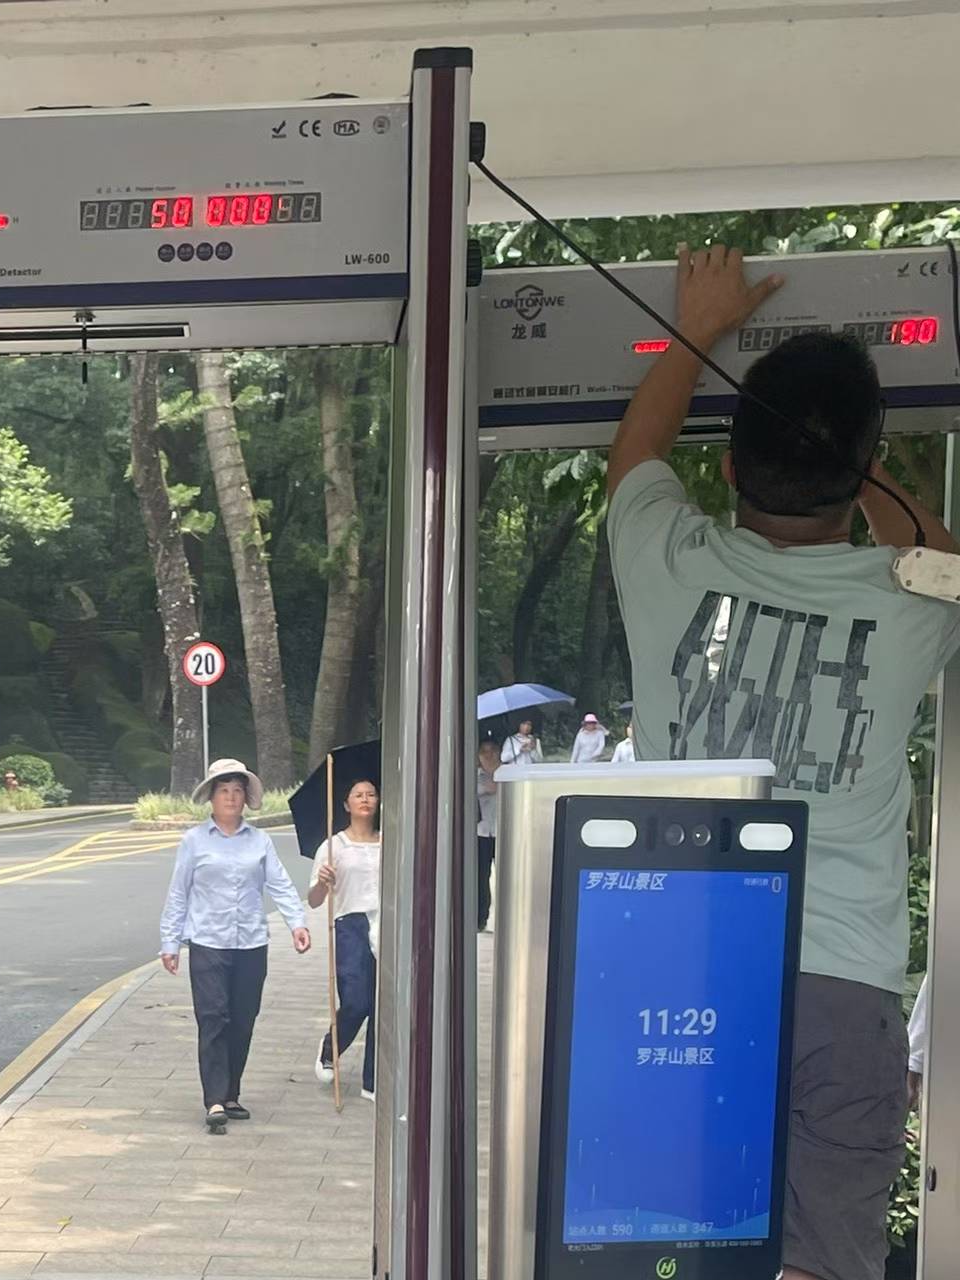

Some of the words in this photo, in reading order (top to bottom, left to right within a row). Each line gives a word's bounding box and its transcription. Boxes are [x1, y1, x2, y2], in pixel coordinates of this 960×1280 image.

[299, 120, 321, 137] CE
[344, 252, 390, 265] LW-600
[920, 261, 938, 276] CE
[511, 322, 547, 339] 龙威
[192, 652, 215, 675] 20
[585, 872, 668, 891] 罗浮山景区
[638, 1008, 717, 1035] 11:29
[636, 1047, 716, 1066] 罗浮山景区
[612, 1223, 633, 1236] 590
